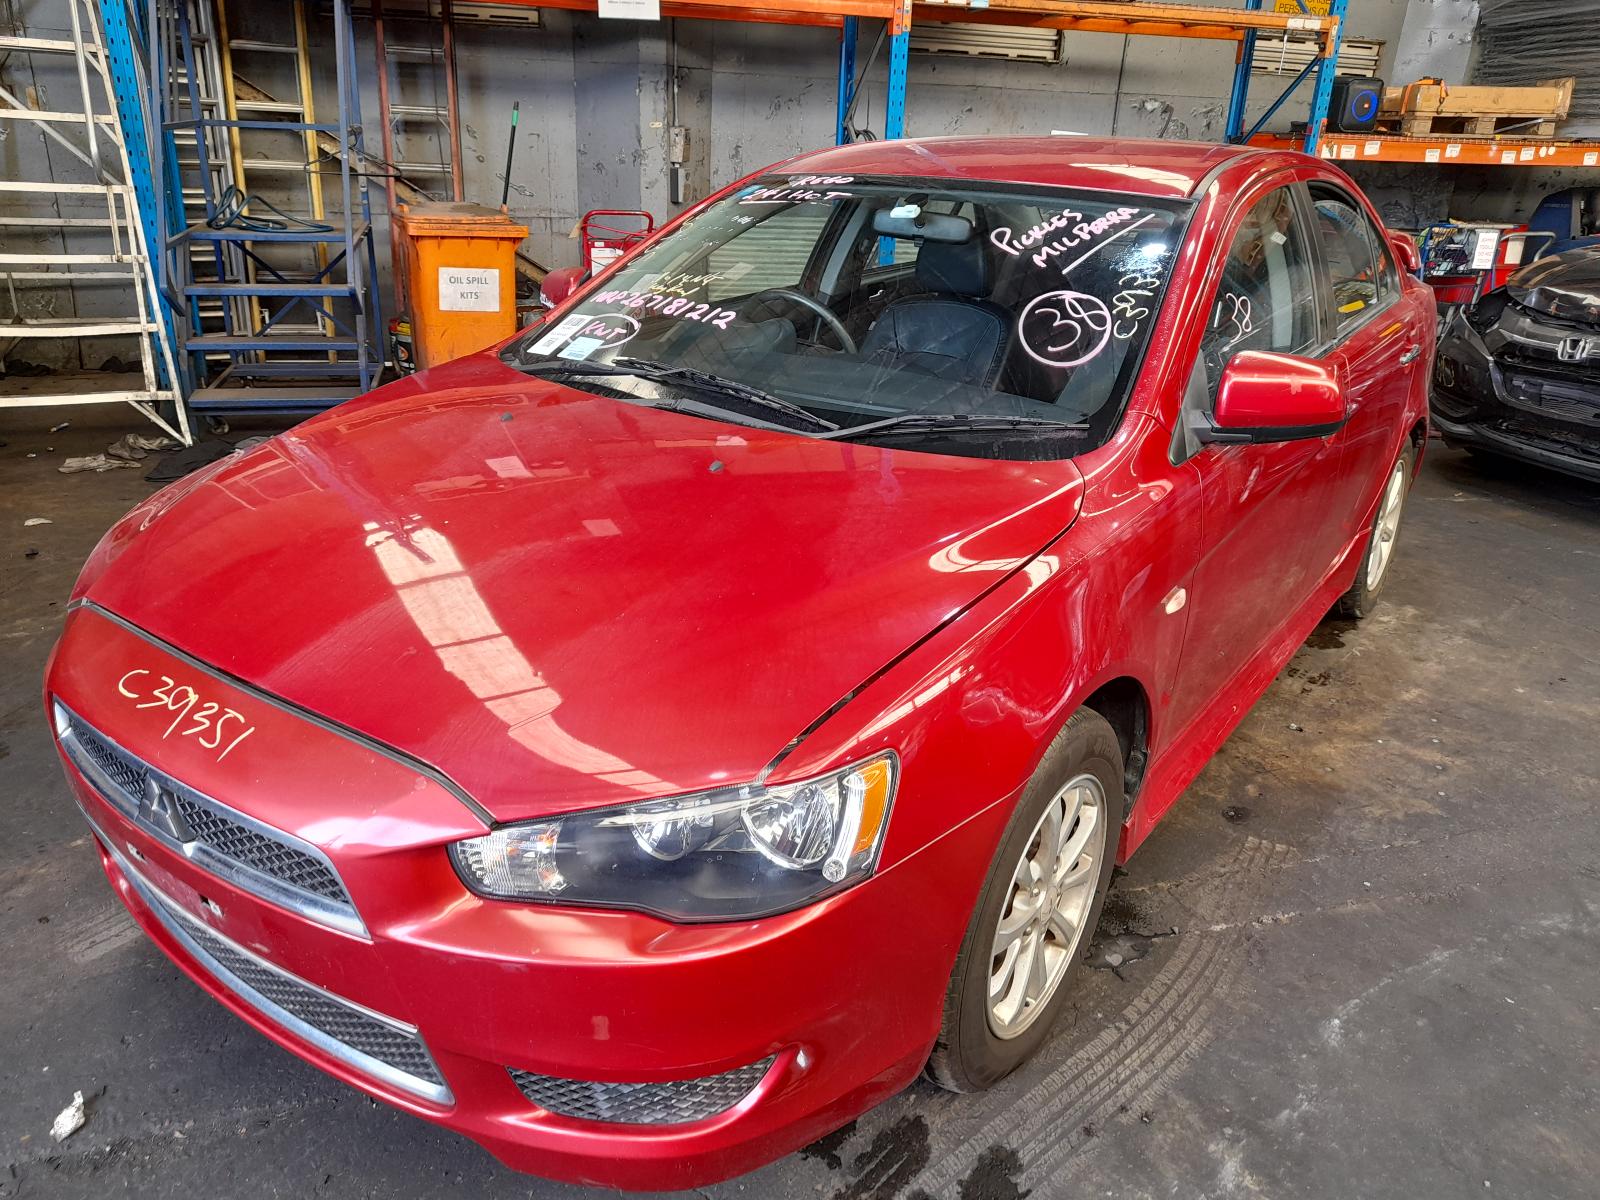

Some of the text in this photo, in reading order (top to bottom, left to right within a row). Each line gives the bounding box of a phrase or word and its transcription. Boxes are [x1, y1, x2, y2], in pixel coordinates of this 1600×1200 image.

[990, 208, 1083, 256] PICKLES
[448, 275, 489, 286] OIL SPILL
[459, 291, 480, 301] KITS
[1034, 295, 1111, 352] 38
[1225, 292, 1253, 343] 38
[118, 669, 255, 763] C39351
